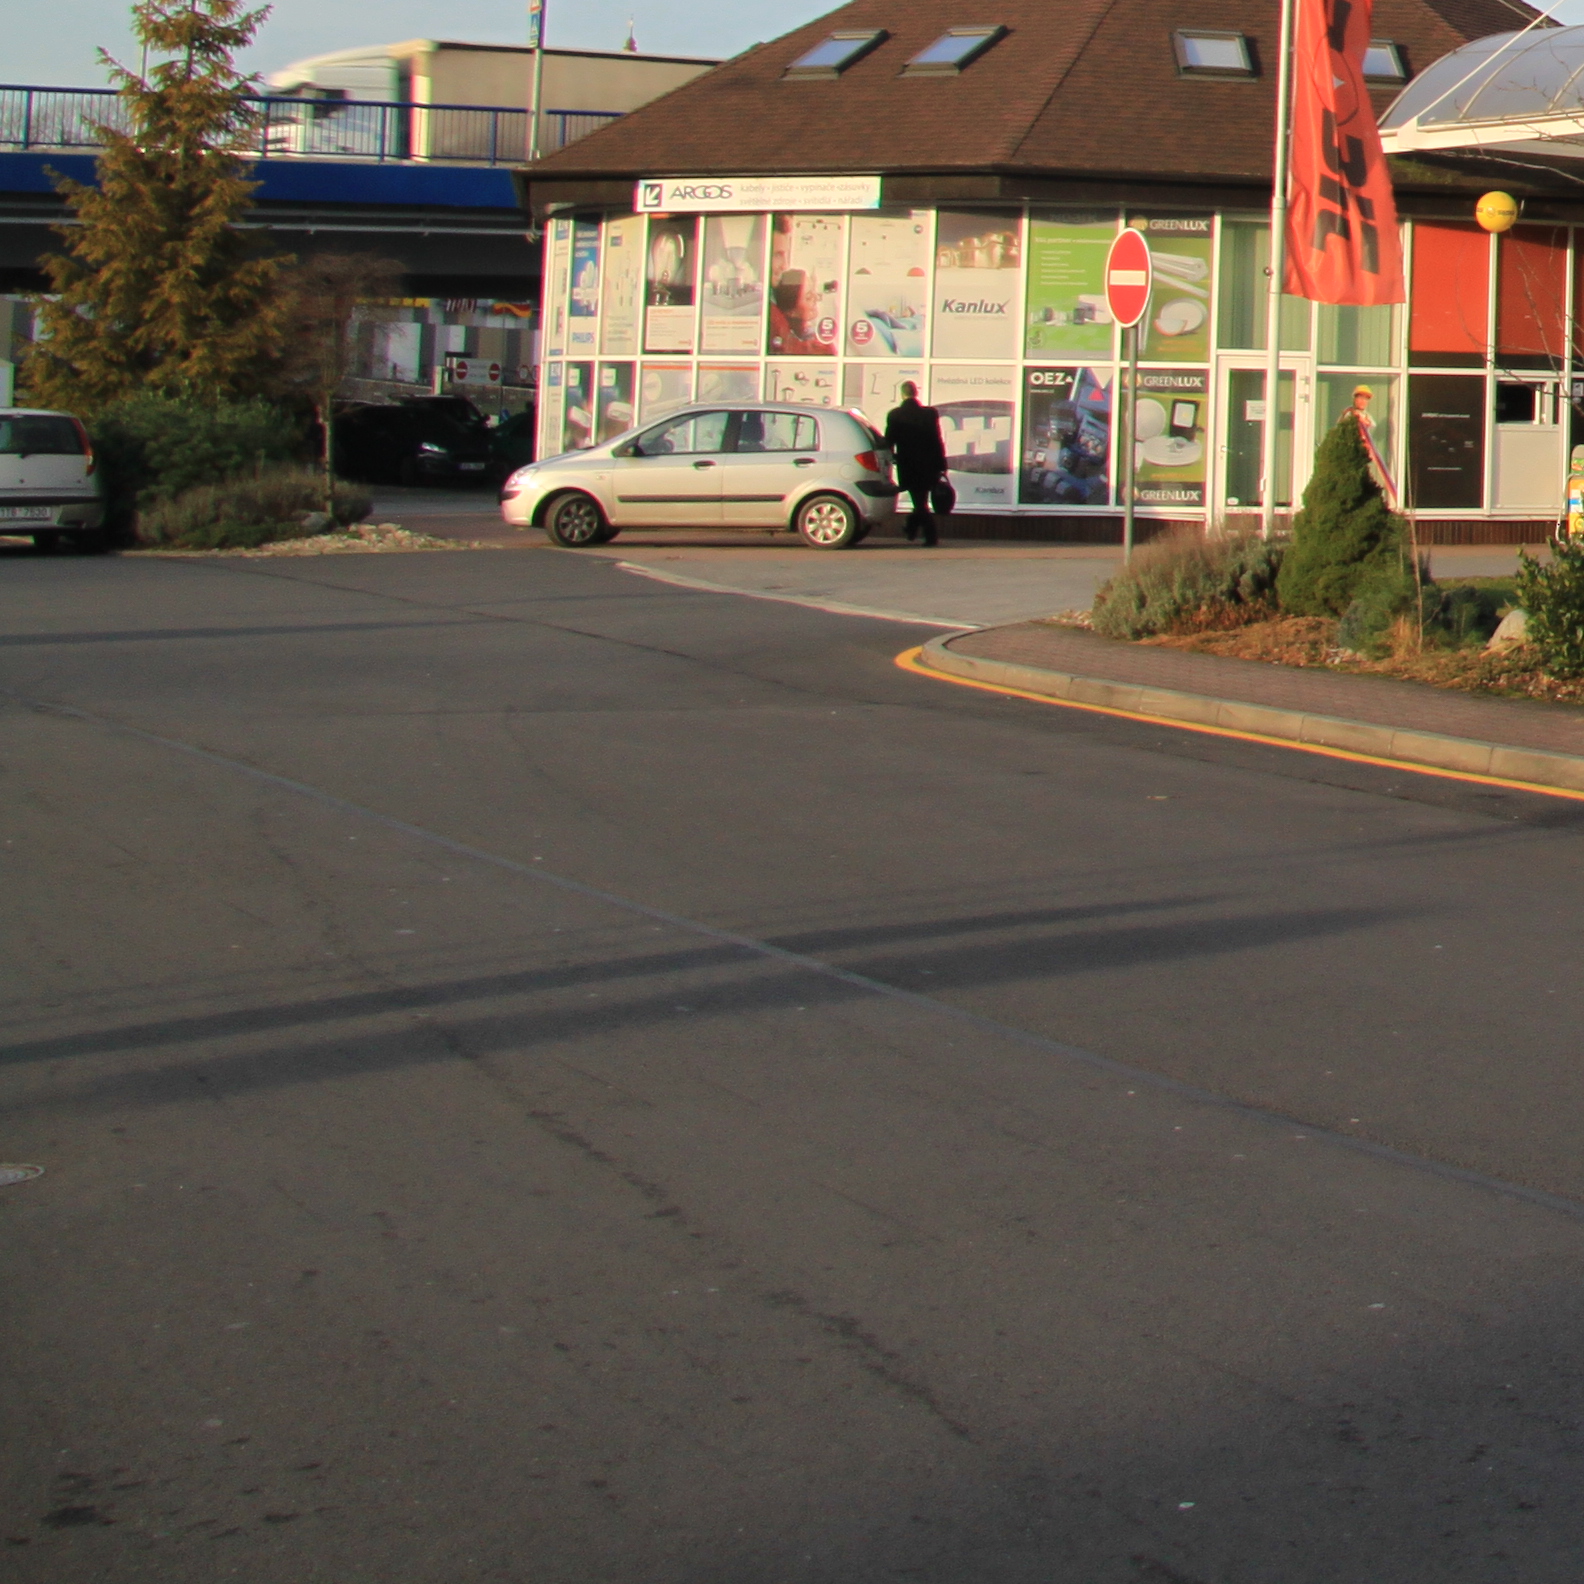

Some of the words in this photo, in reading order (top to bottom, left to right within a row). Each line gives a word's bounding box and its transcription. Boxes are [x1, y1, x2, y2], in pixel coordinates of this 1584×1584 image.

[669, 184, 733, 199] ARGOS
[1150, 219, 1209, 231] GREENLUX
[942, 299, 1012, 314] Kanlux
[823, 319, 834, 330] 5
[856, 323, 869, 333] 5
[1030, 372, 1066, 385] OEZ
[1143, 376, 1204, 387] GREENLUX
[1141, 490, 1201, 501] GREENLUX
